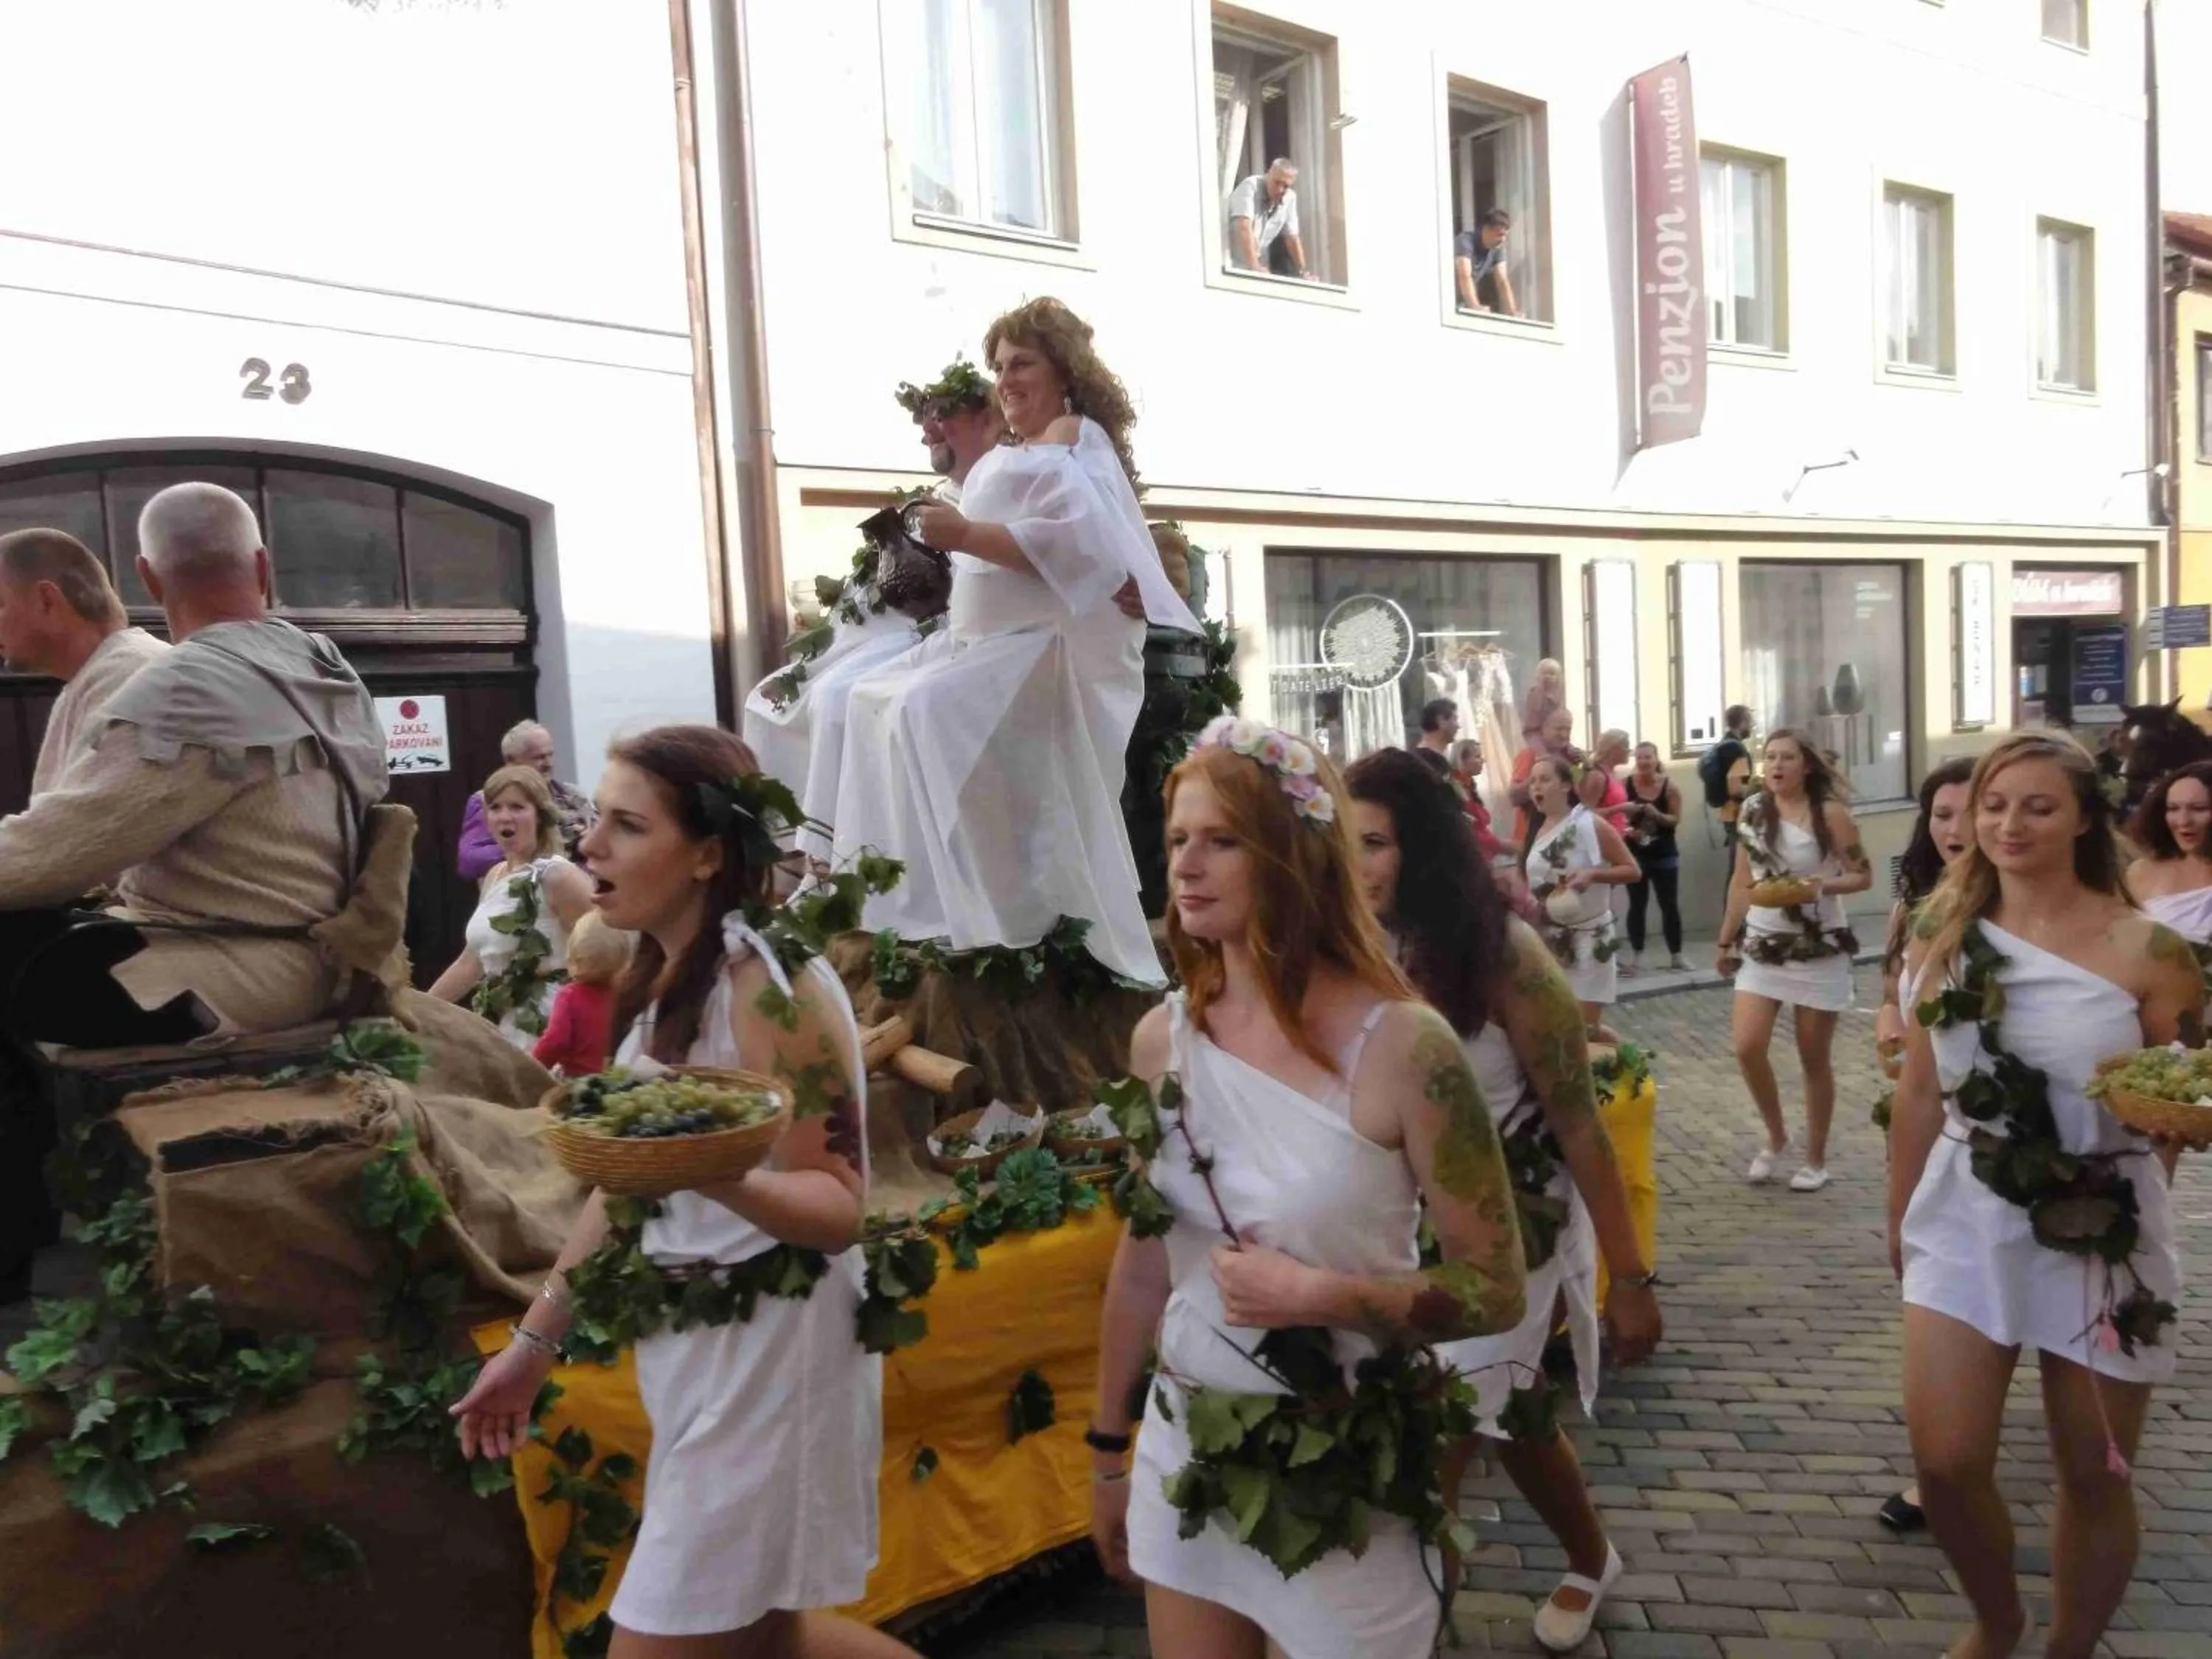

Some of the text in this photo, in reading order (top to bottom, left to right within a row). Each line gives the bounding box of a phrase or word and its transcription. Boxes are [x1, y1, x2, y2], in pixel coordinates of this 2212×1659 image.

[1646, 75, 1697, 415] Penzion u hradeb
[239, 357, 312, 405] 23
